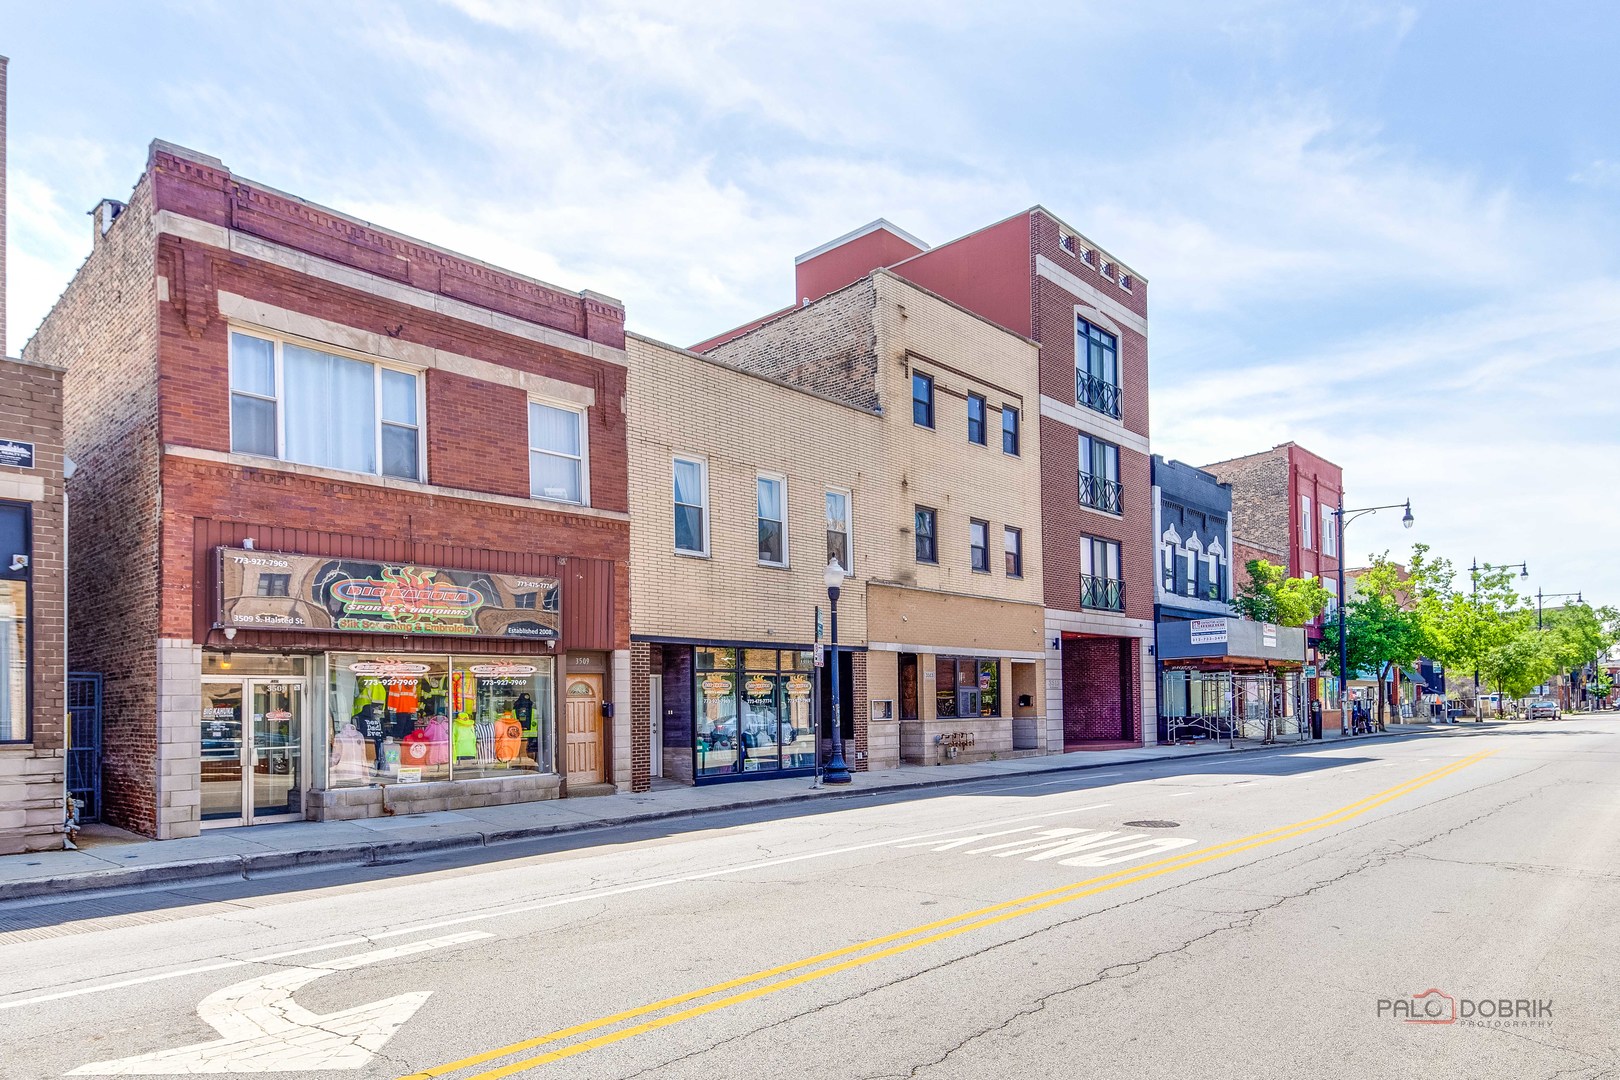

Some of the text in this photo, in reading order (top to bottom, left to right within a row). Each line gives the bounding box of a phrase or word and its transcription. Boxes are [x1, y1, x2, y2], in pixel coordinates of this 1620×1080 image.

[233, 556, 288, 567] 773-927-7969
[346, 585, 469, 602] BIG KAHUNA
[347, 603, 397, 612] SPORTS
[410, 607, 469, 616] UNIFORMS
[233, 614, 254, 623] 3509
[264, 616, 294, 624] Halsted
[339, 619, 477, 635] Silk Screening & Embroidery
[508, 627, 539, 635] Established
[575, 657, 590, 665] 3509
